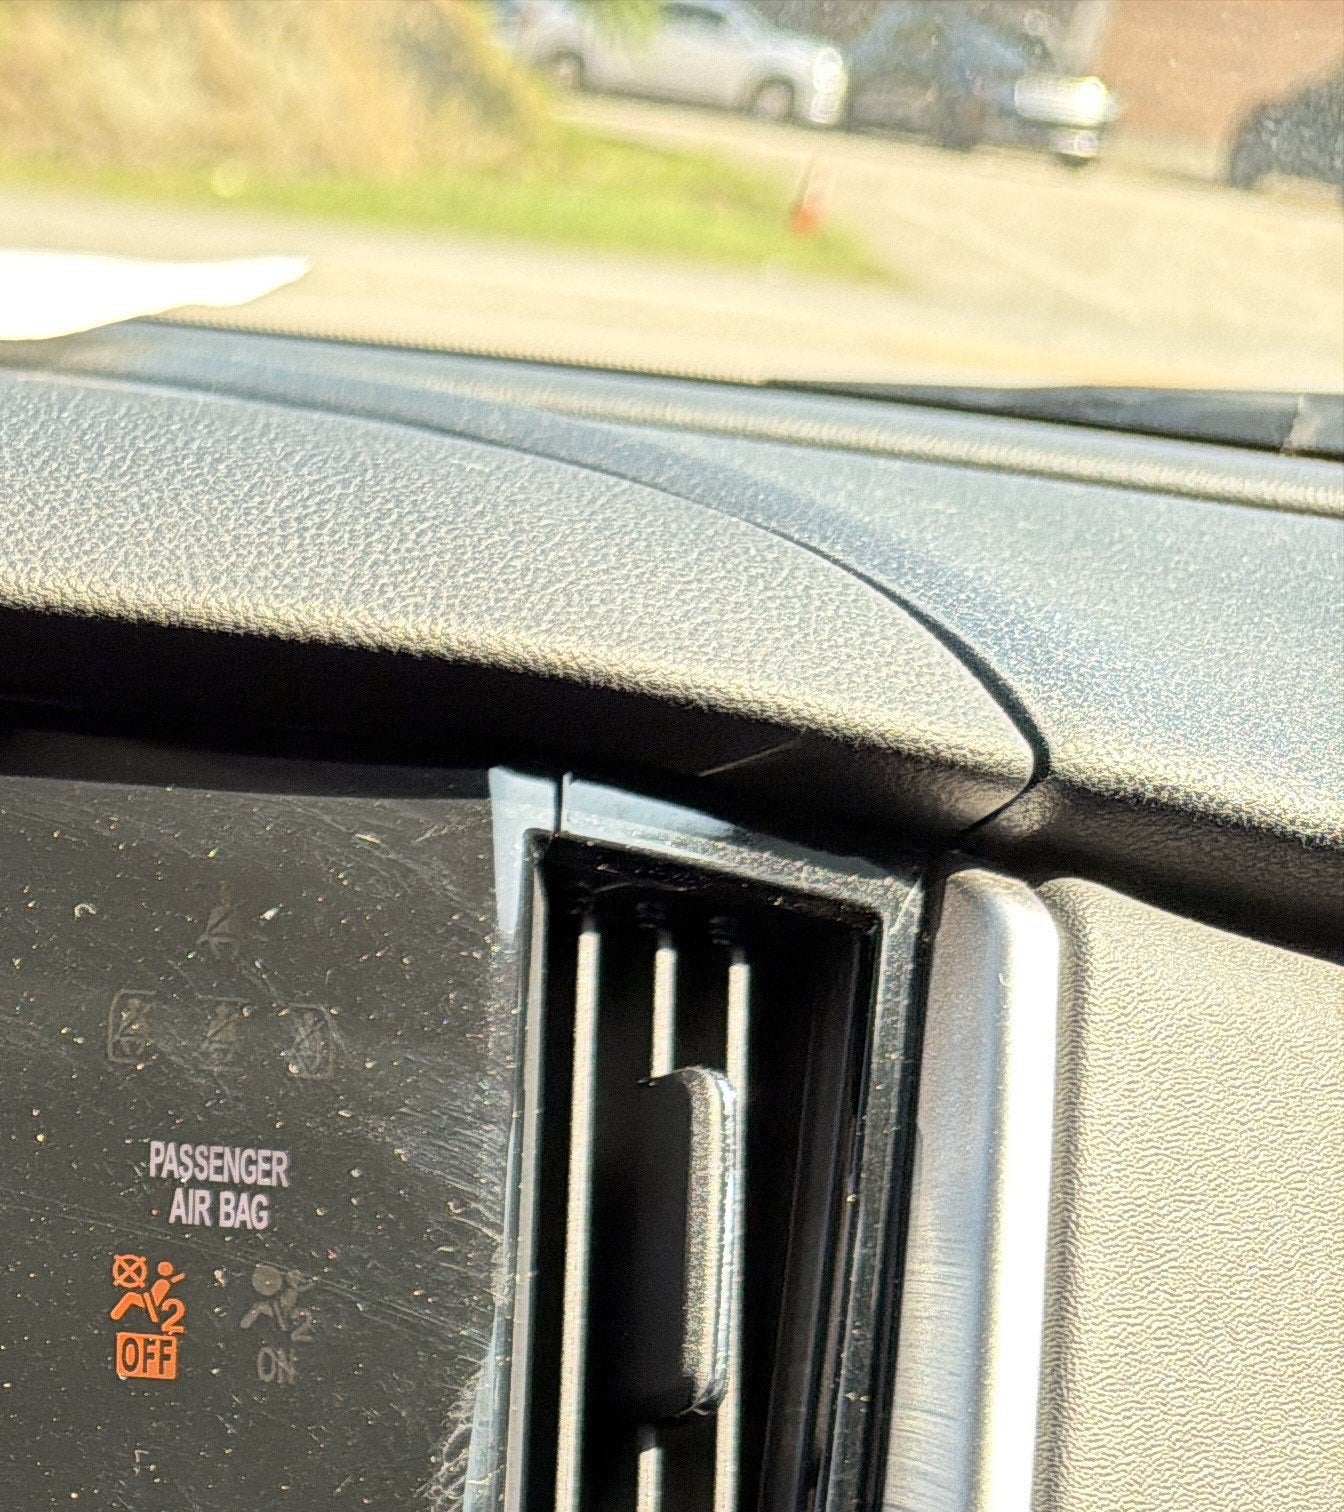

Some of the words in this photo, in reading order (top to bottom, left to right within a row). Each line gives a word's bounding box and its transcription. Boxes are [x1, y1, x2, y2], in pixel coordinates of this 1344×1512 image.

[149, 1140, 289, 1188] PASSENGER
[169, 1187, 212, 1227] AIR
[218, 1193, 269, 1230] BAG
[119, 1335, 175, 1377] OFF
